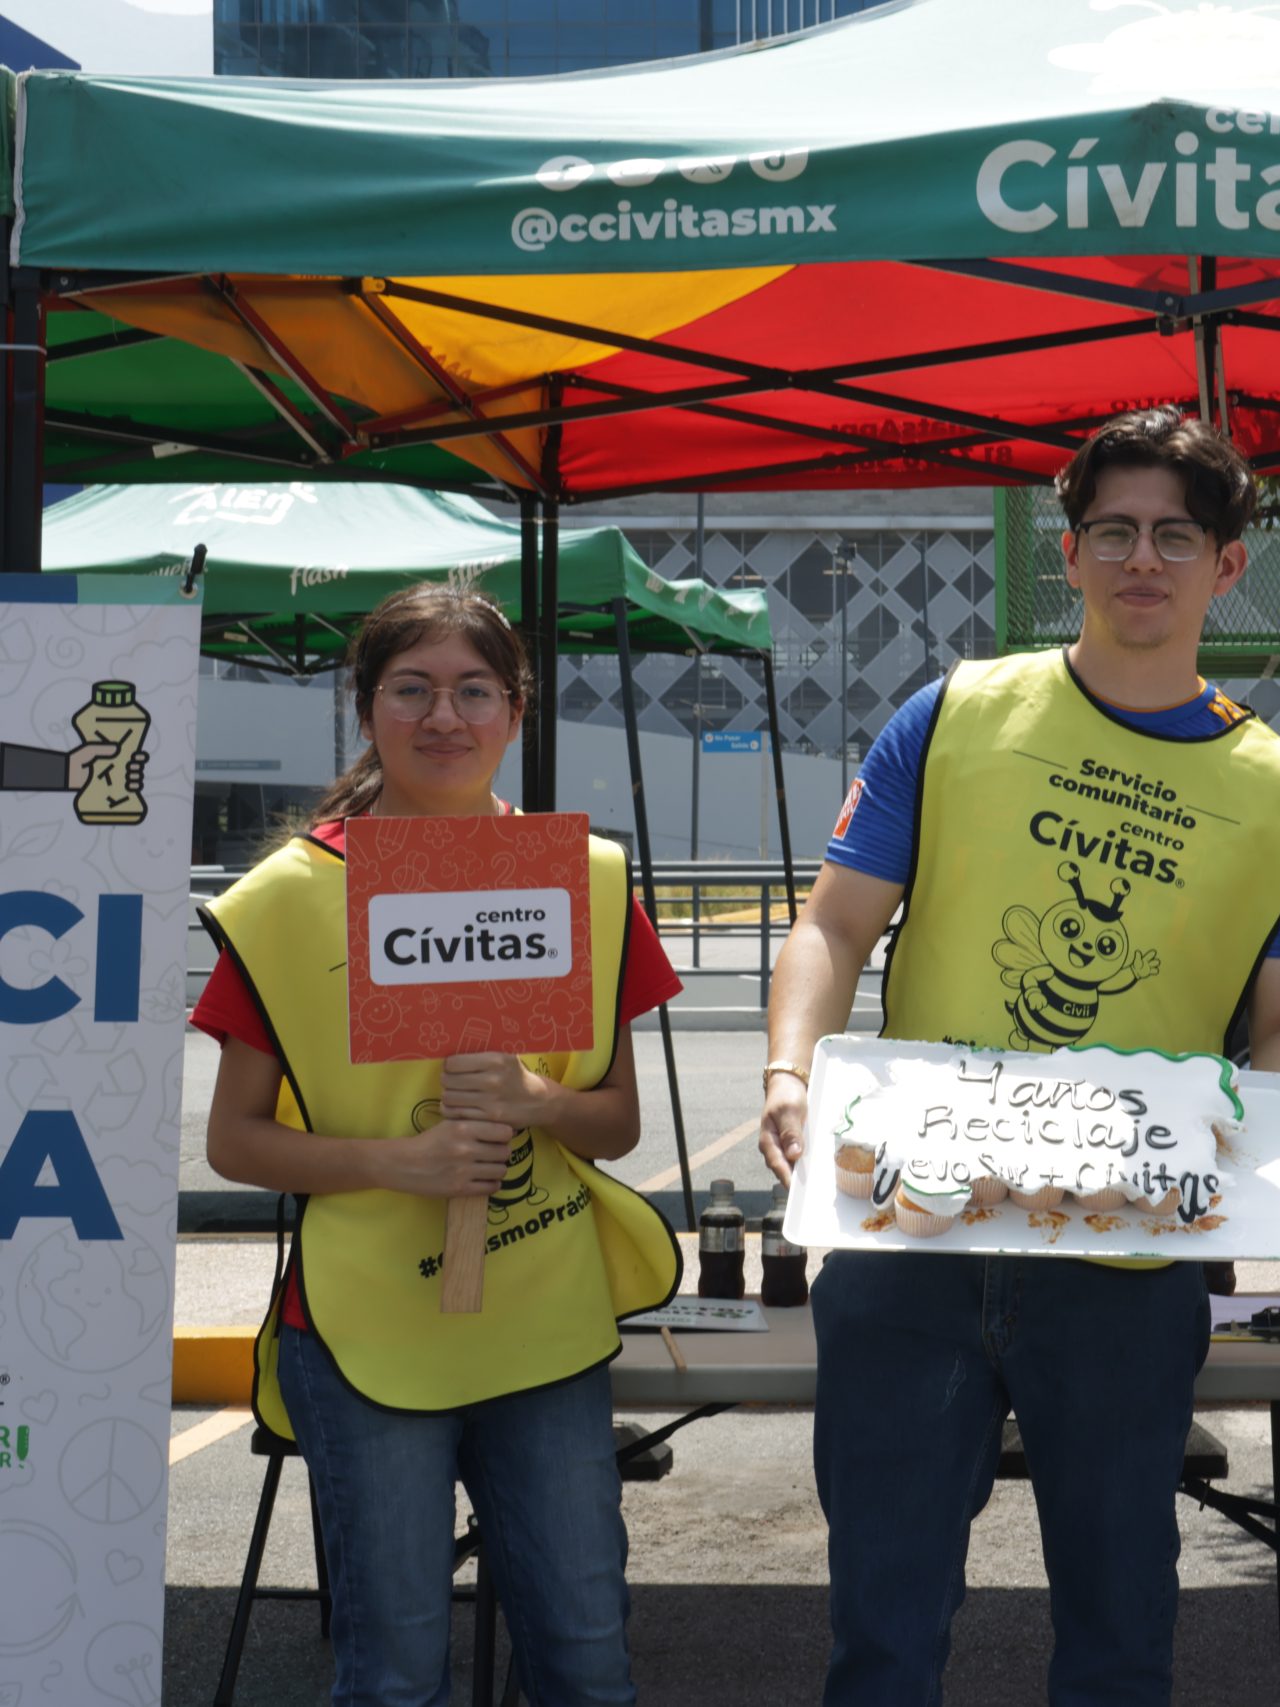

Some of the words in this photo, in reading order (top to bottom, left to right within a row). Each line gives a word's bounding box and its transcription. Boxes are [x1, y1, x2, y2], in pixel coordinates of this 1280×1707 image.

[511, 198, 838, 252] @ccivitasmx
[1049, 774, 1196, 829] comunitario
[1080, 758, 1177, 802] Servicio
[1120, 821, 1184, 851] centro
[475, 907, 546, 923] centro
